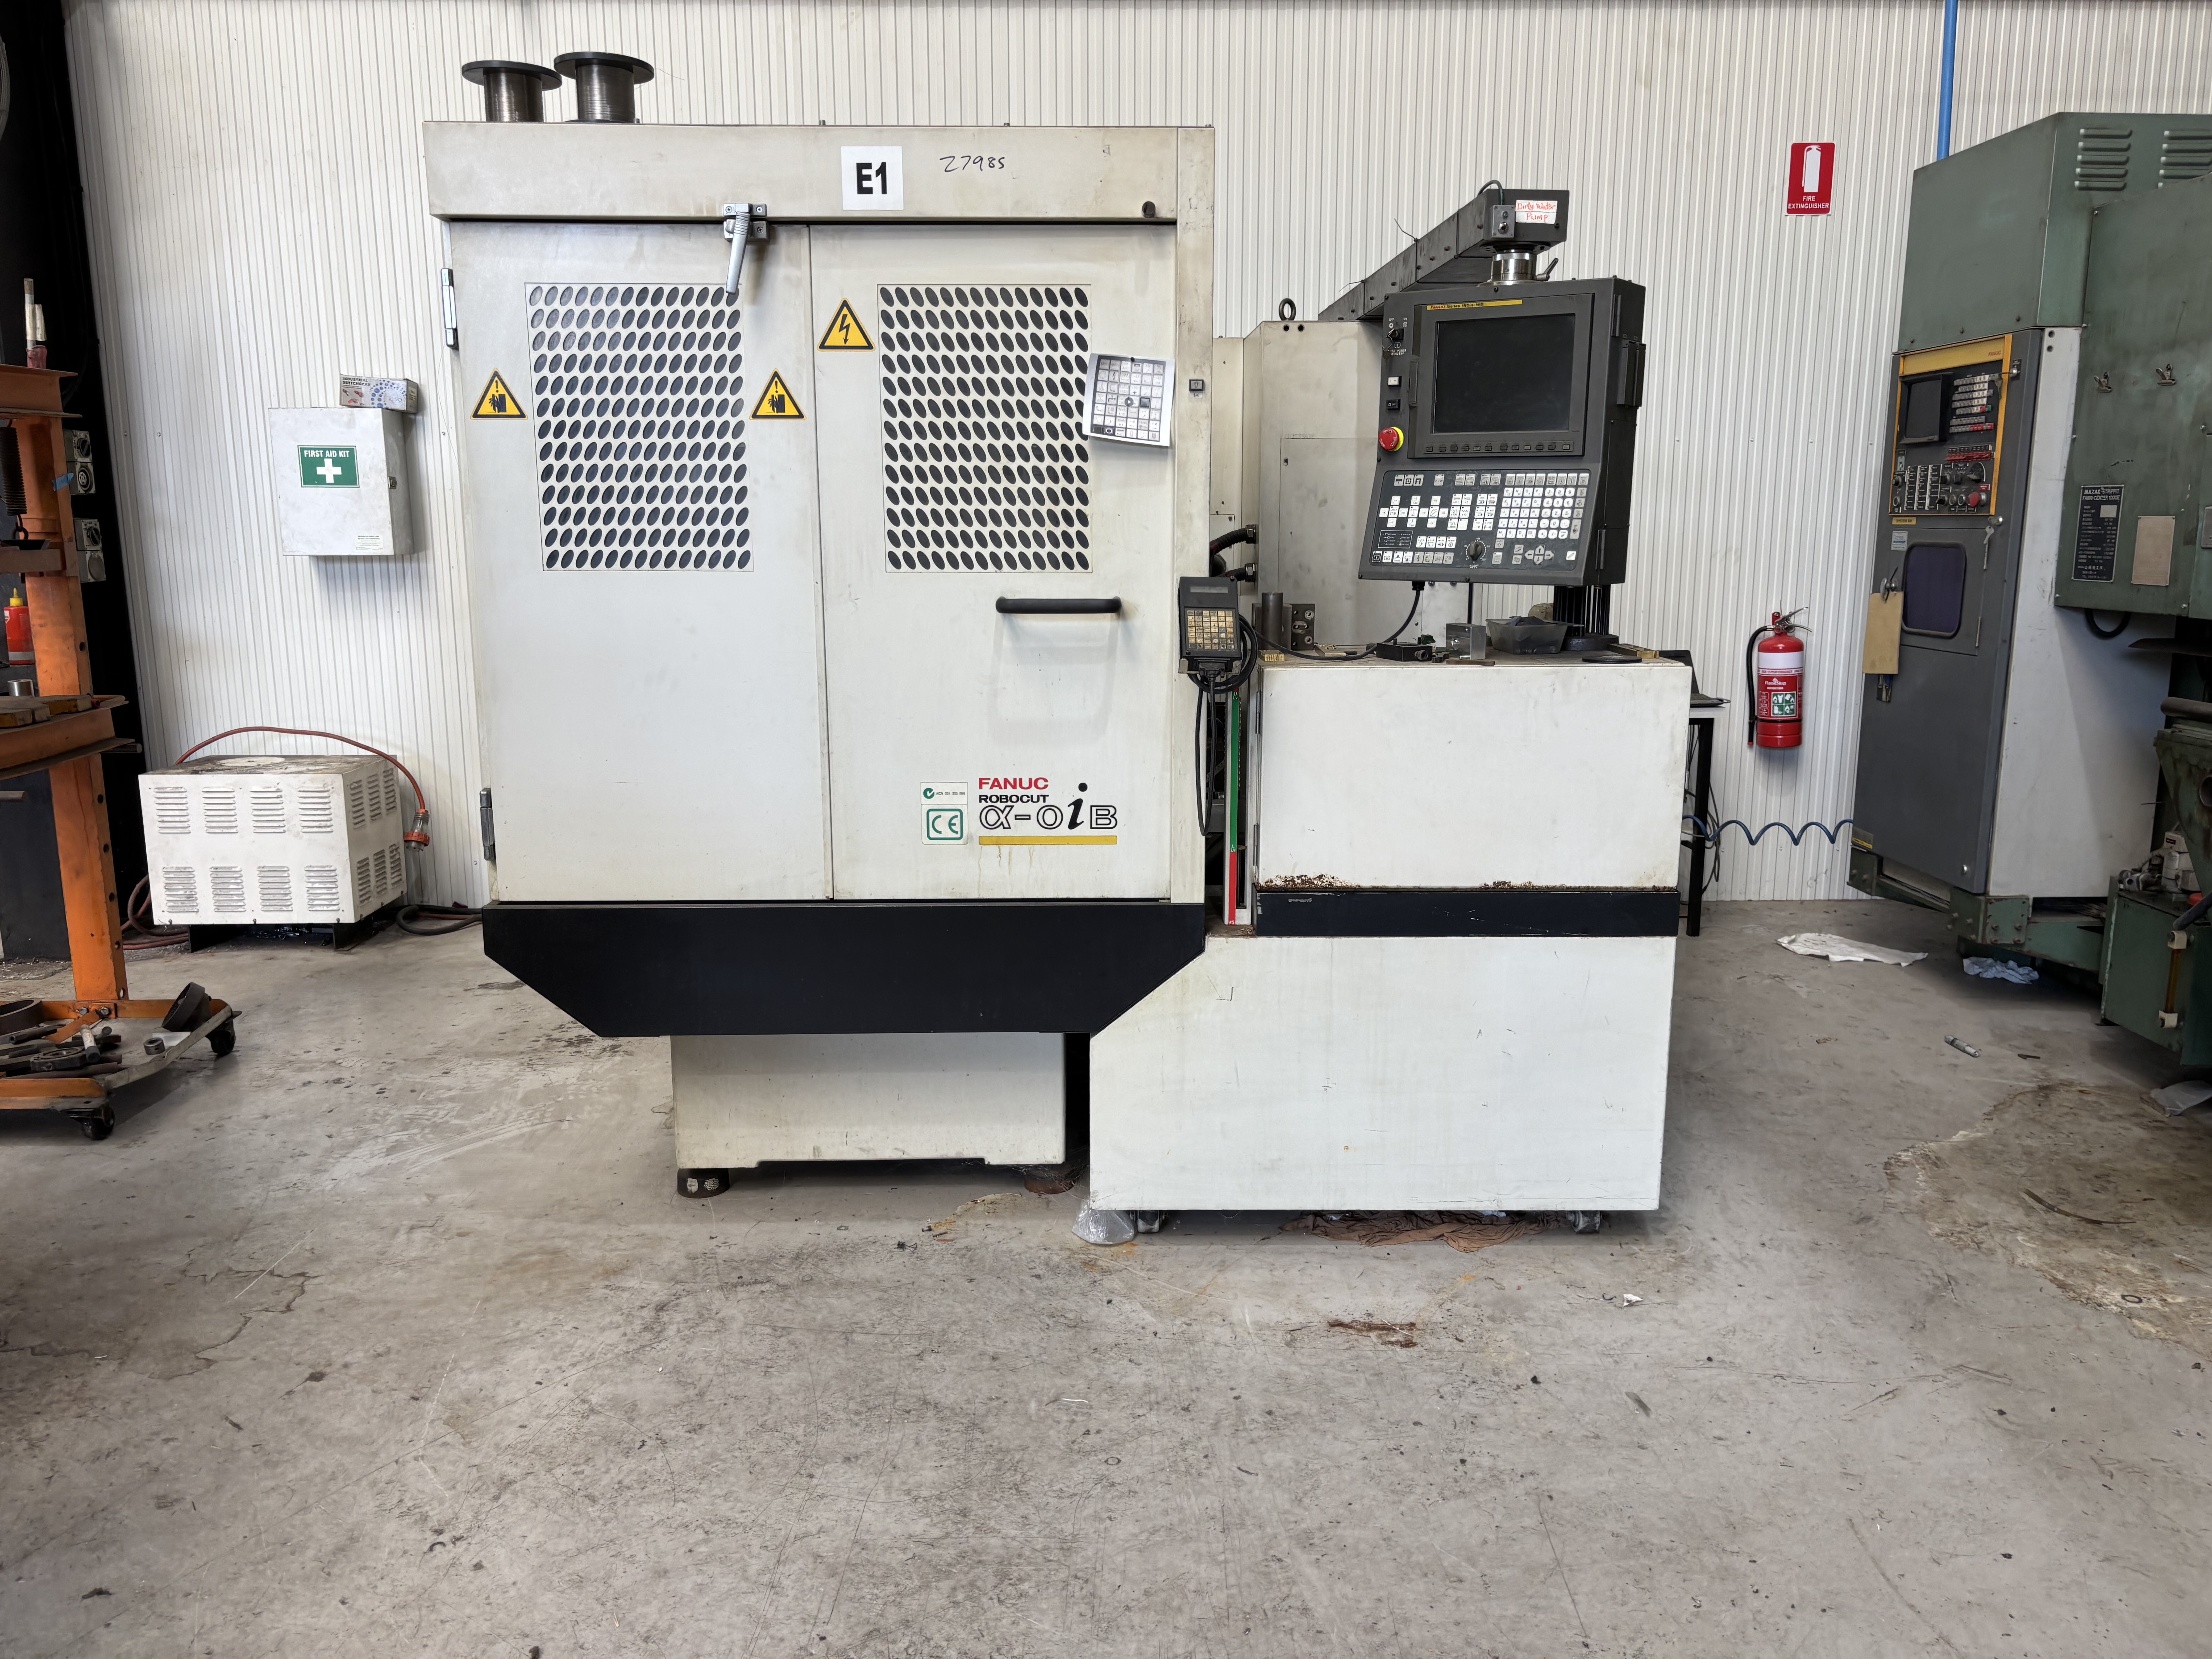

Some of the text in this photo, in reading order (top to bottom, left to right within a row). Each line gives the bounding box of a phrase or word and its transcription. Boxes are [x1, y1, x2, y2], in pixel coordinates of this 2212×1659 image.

[856, 162, 887, 194] E1
[1517, 202, 1534, 211] Dirty
[1527, 213, 1548, 223] Pump
[979, 777, 1049, 790] FANUC
[979, 794, 1049, 803] ROBOCUT
[931, 815, 958, 834] CE
